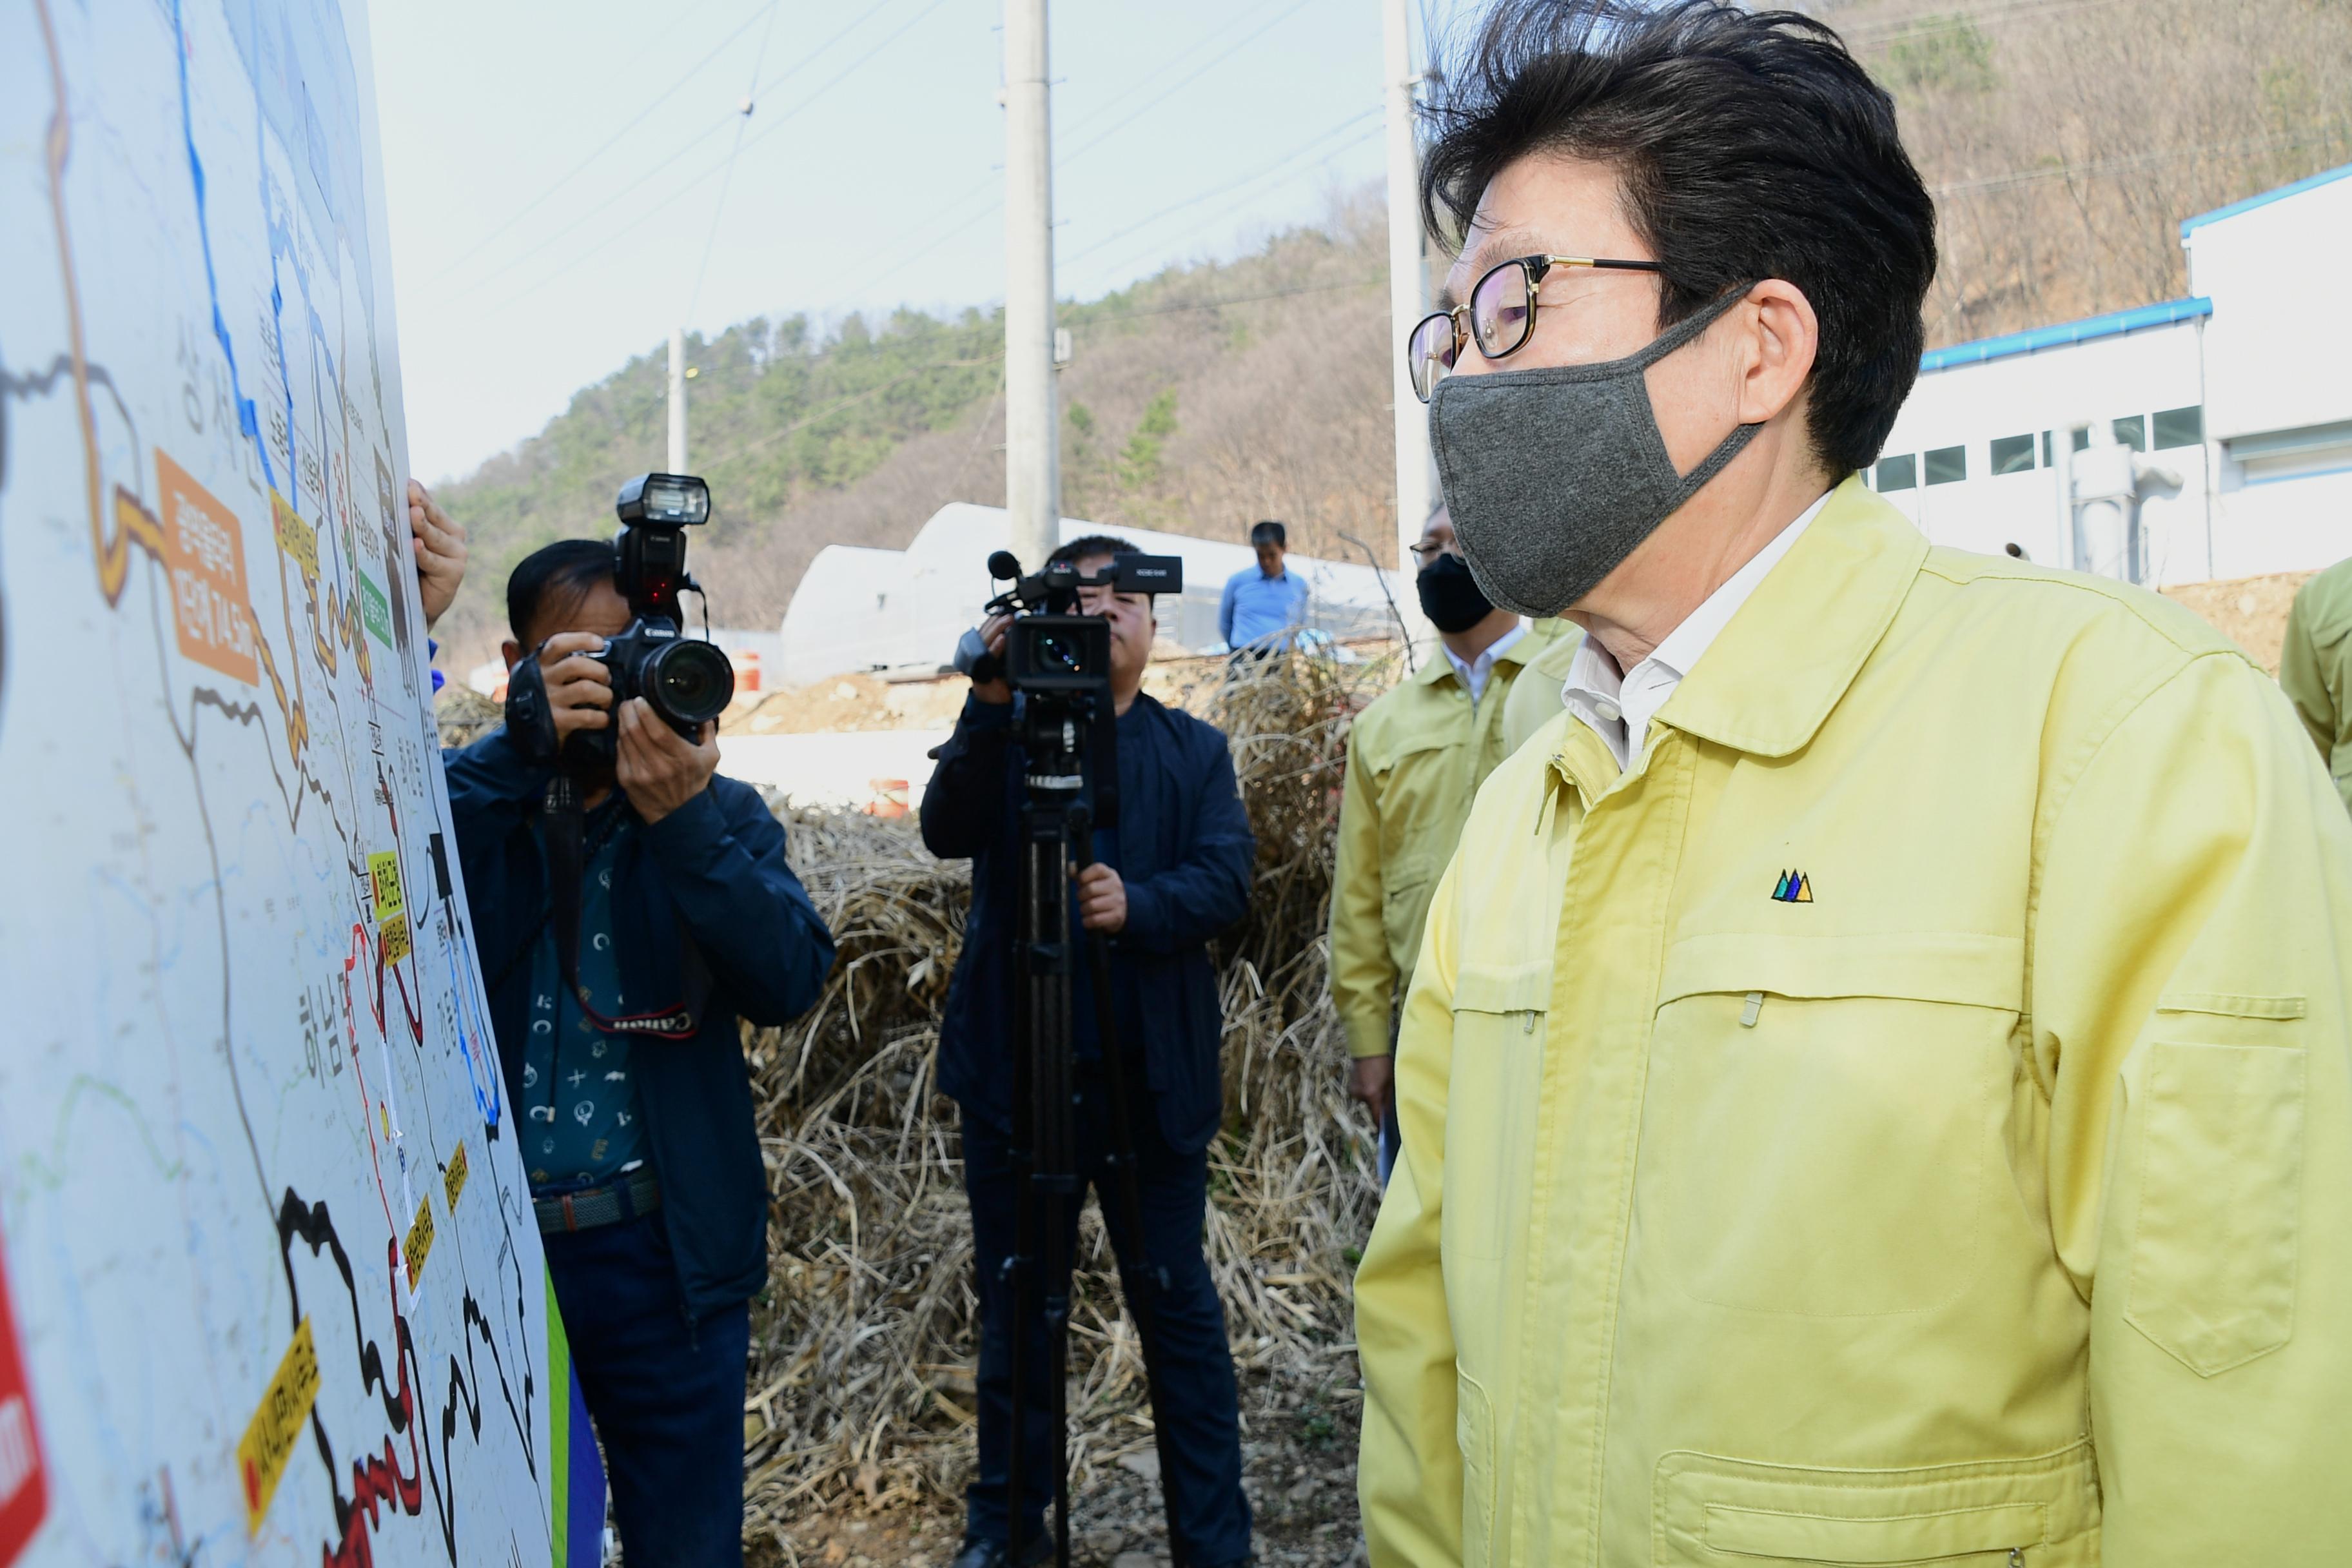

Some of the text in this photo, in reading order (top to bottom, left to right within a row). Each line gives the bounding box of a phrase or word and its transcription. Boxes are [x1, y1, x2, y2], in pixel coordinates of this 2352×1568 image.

[645, 629, 674, 638] Canon
[377, 858, 402, 909] 화천군청
[299, 972, 360, 1090] 하남면
[614, 1013, 691, 1031] Canon
